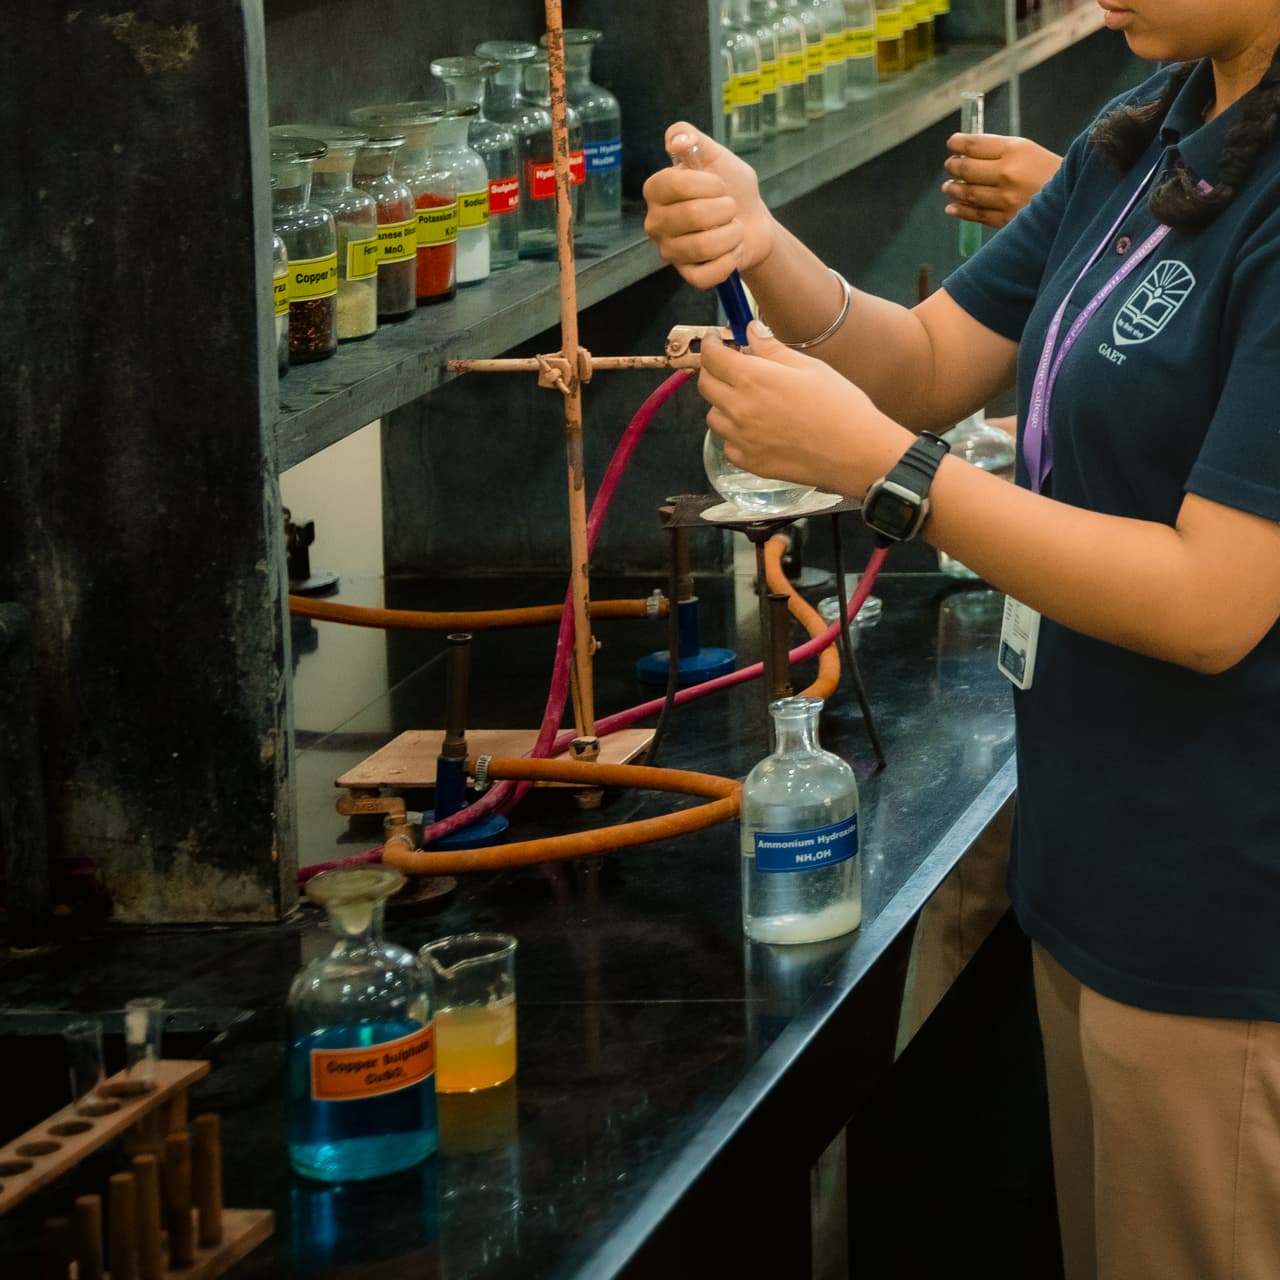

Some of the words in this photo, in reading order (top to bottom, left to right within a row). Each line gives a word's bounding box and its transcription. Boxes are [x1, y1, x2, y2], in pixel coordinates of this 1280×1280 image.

[295, 271, 329, 285] Copper
[1098, 343, 1127, 366] GAET
[758, 839, 815, 849] Ammonium
[817, 823, 856, 845] Hydroxide
[326, 1057, 378, 1075] Copper
